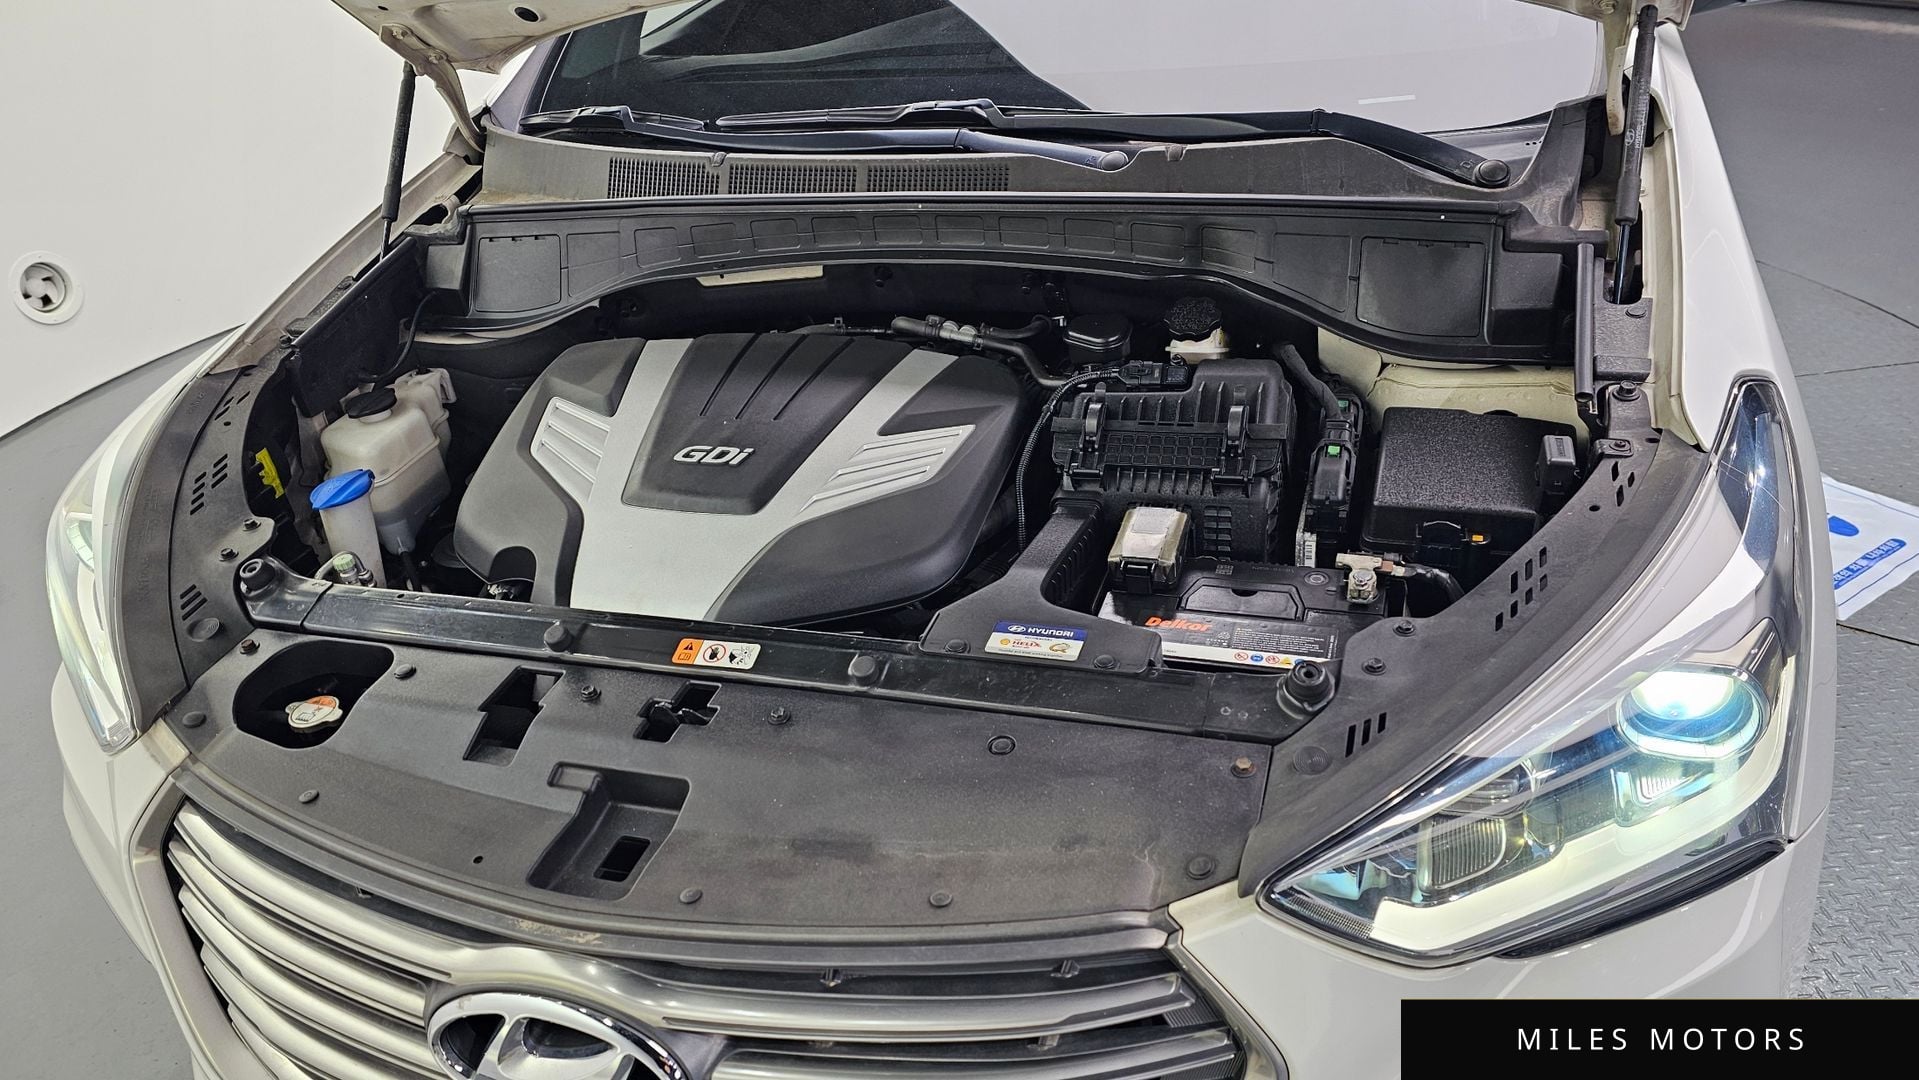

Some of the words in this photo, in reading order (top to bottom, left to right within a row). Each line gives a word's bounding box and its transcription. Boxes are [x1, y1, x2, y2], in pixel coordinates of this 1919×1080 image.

[673, 445, 756, 465] GDi
[1028, 627, 1074, 637] HYUNDAI
[1144, 616, 1213, 632] Delkor
